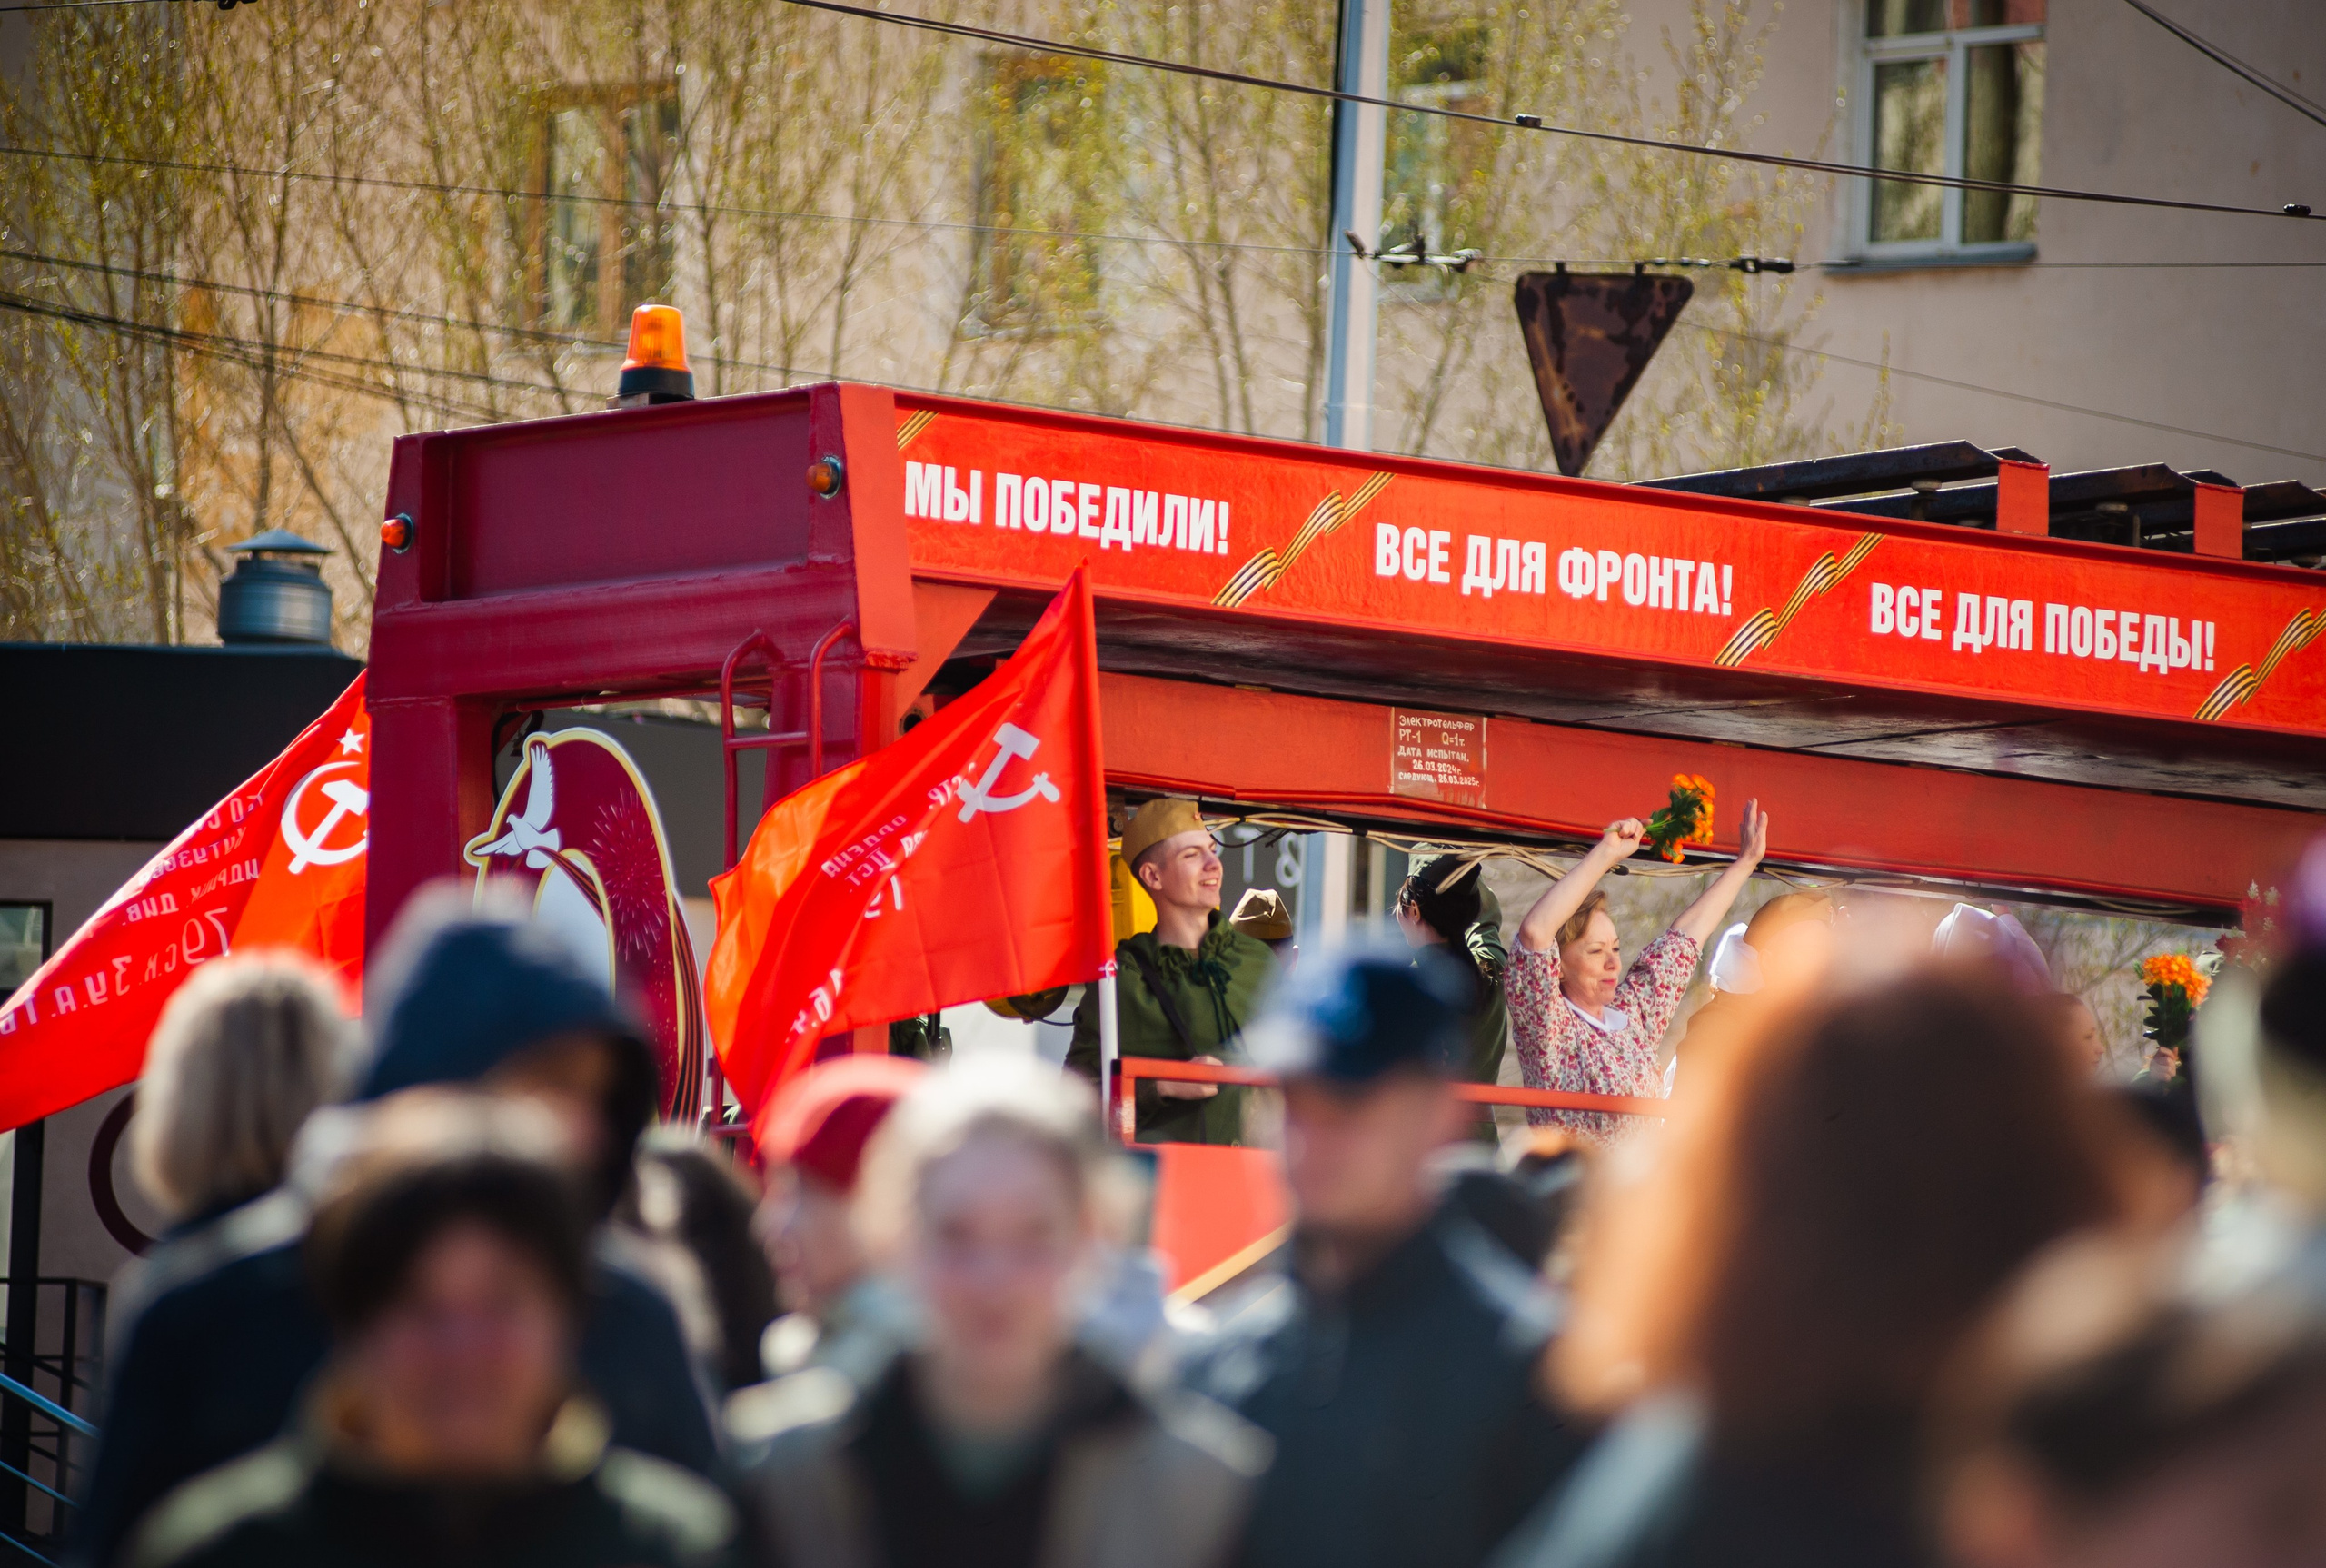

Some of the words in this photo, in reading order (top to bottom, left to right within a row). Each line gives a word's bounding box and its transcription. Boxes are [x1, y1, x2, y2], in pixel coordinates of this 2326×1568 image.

[904, 461, 981, 523] МЫ
[995, 472, 1229, 554] ПОБЕДИЛИ!
[1376, 522, 1451, 583] ВСЕ
[1462, 534, 1546, 598] ДЛЯ
[1559, 546, 1733, 615] ФРОНТА!
[1872, 582, 1942, 640] ВСЕ
[1953, 592, 2033, 653] ДЛЯ
[2046, 603, 2214, 674] ПОБЕДЫ!
[1398, 745, 1422, 757] ДАТА
